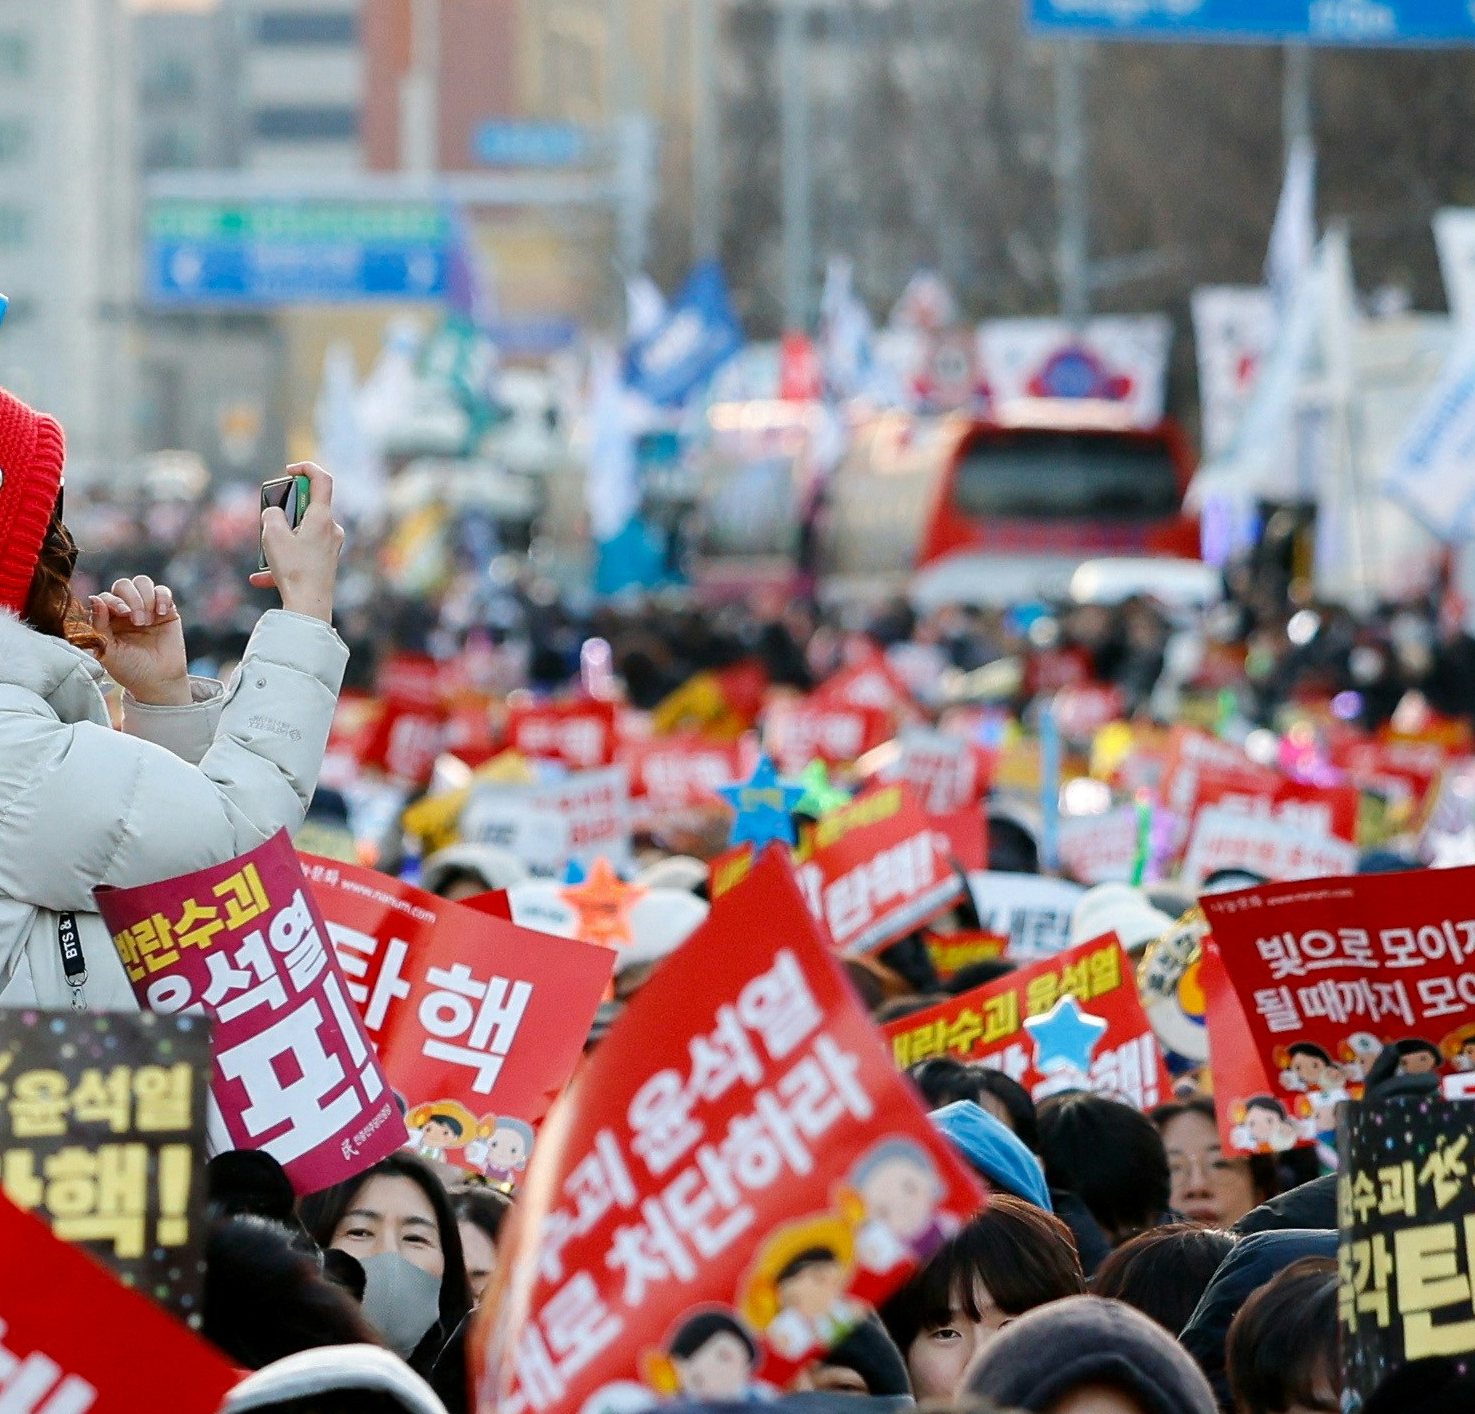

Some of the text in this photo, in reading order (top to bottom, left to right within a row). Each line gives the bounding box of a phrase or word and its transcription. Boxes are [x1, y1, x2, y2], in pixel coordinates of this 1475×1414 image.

[59, 919, 78, 959] BTS &
[112, 862, 272, 984] 반란수괴
[1254, 927, 1379, 981] 빛으로
[1253, 986, 1304, 1034] 될
[1297, 976, 1417, 1027] 때까지
[6, 1059, 195, 1138] 윤석열
[208, 971, 385, 1168] 포!
[626, 947, 825, 1176] 윤석열
[605, 1031, 874, 1307] 처단하라
